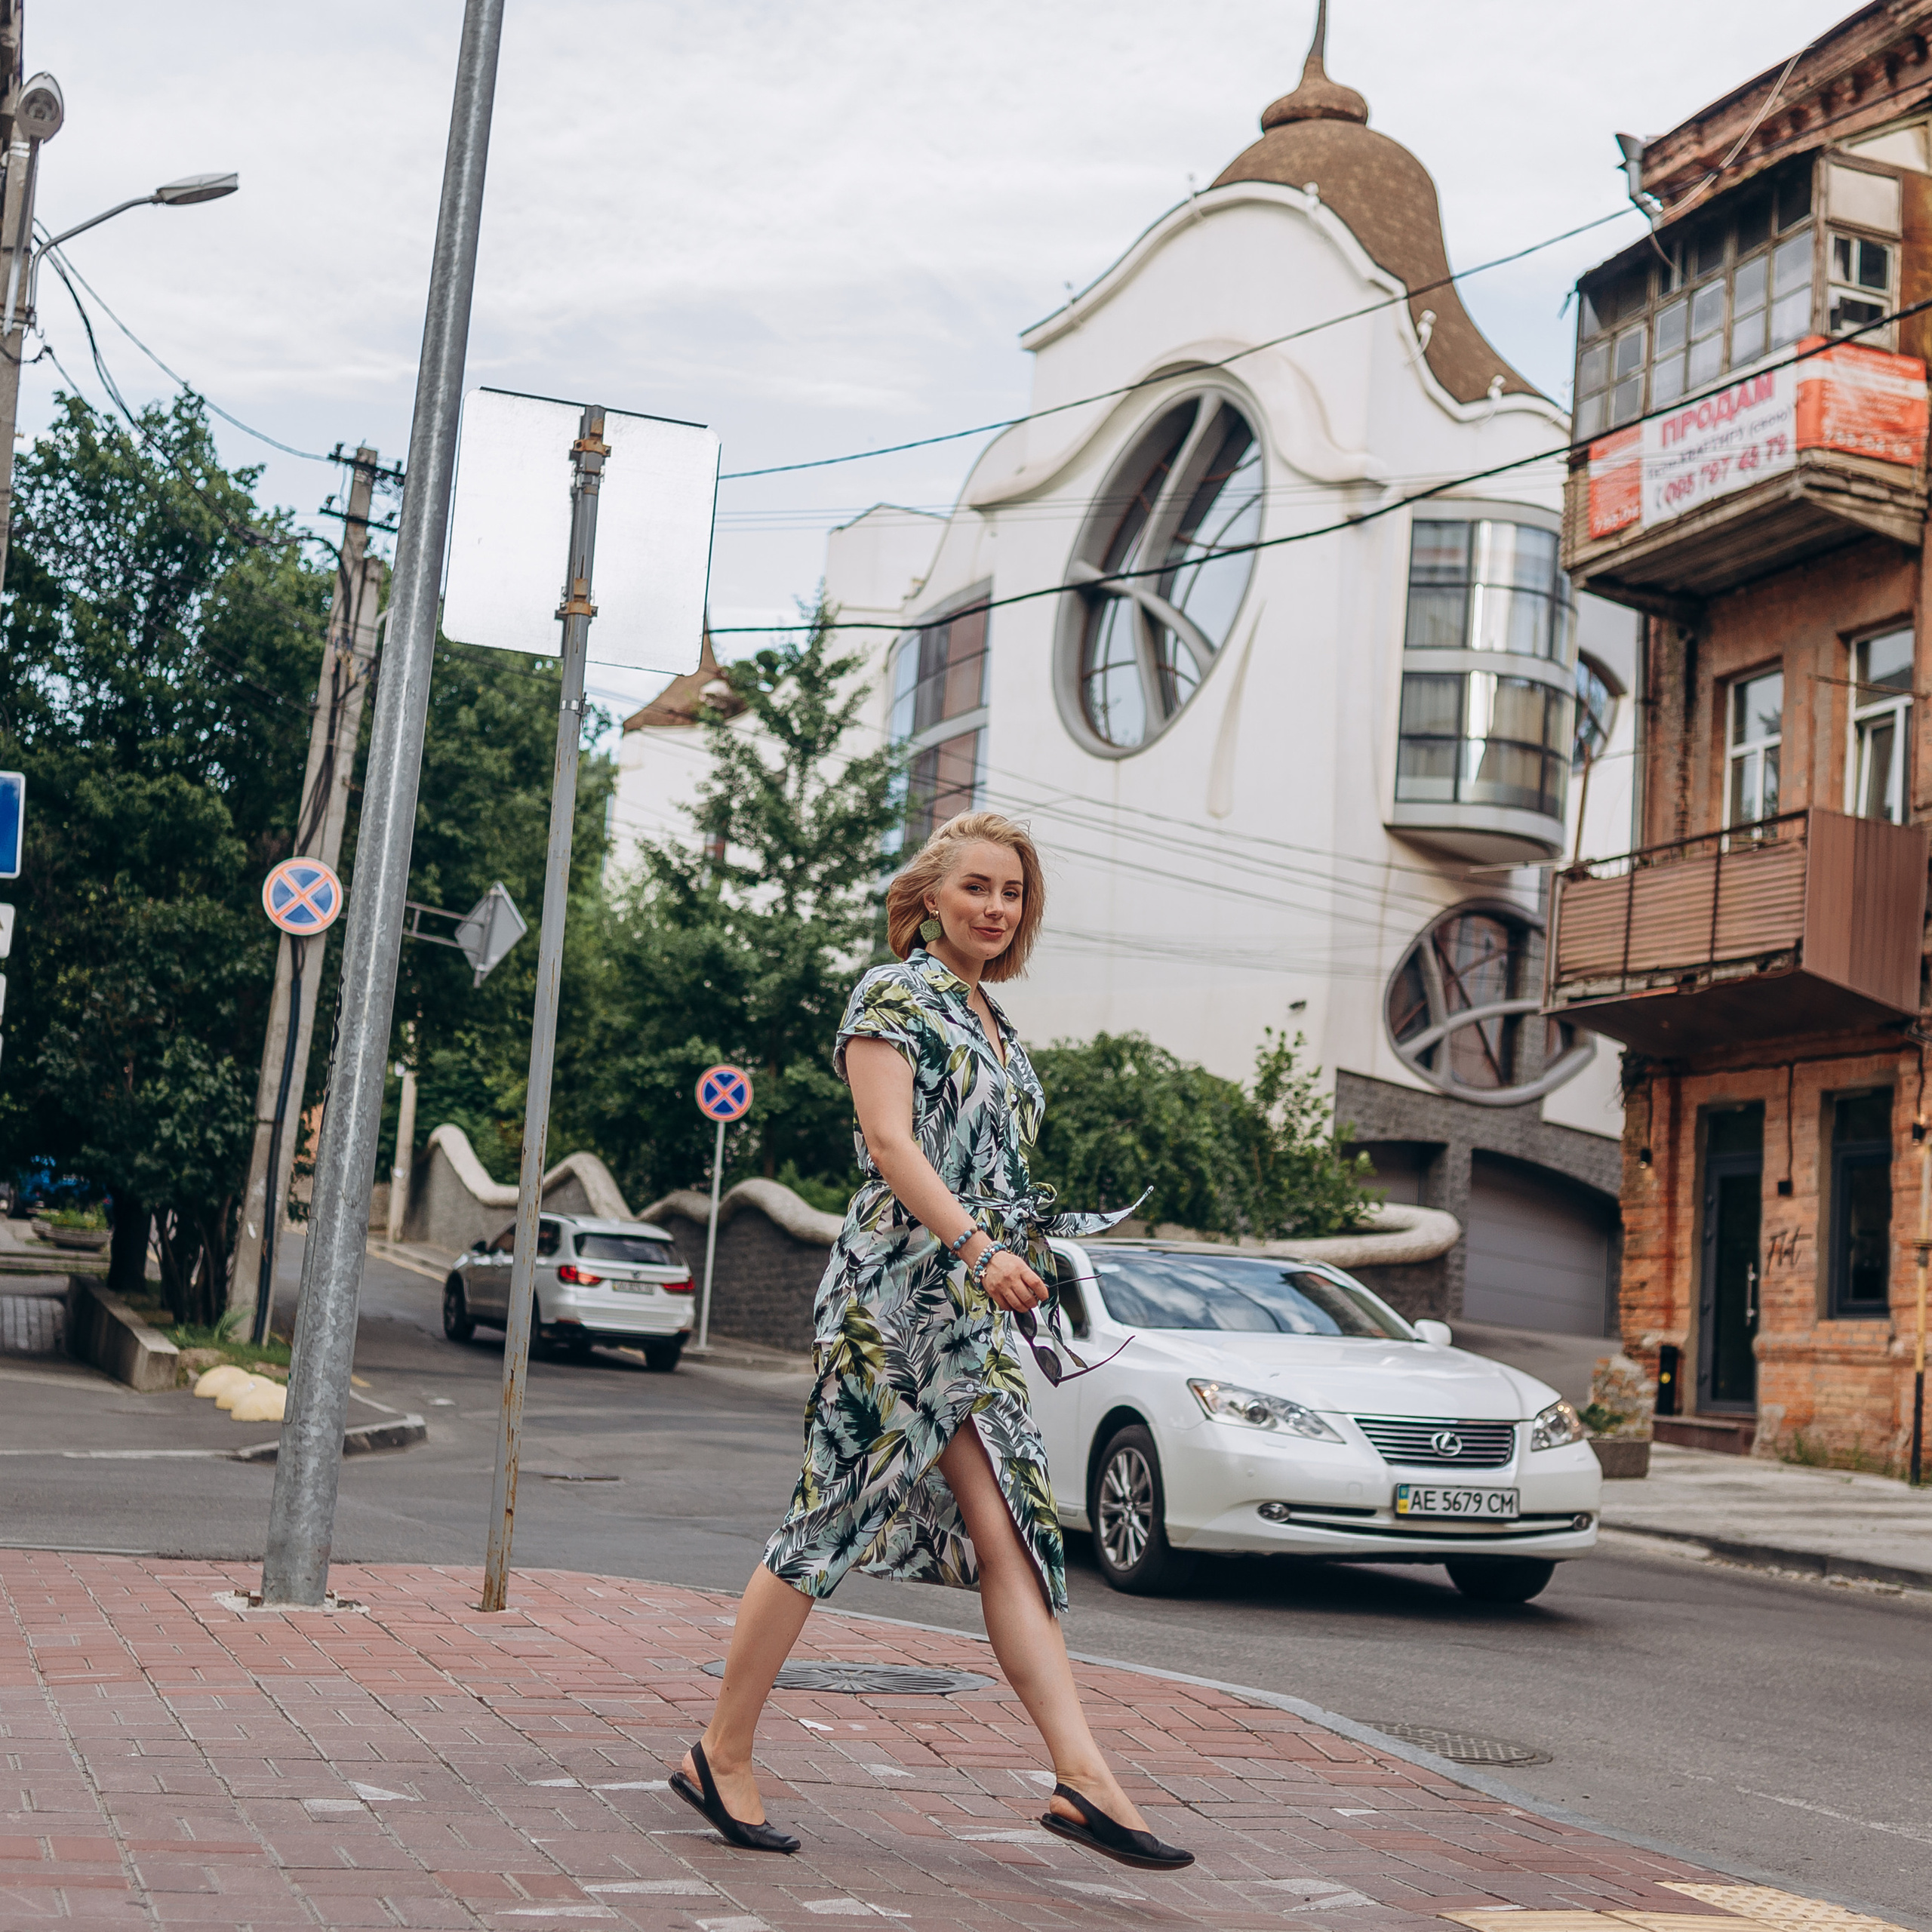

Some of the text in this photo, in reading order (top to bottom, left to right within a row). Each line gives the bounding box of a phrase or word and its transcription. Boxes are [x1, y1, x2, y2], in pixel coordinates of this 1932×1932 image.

[1662, 371, 1774, 448] ПРОДАМ
[1410, 1490, 1514, 1514] AE 5679 CM
